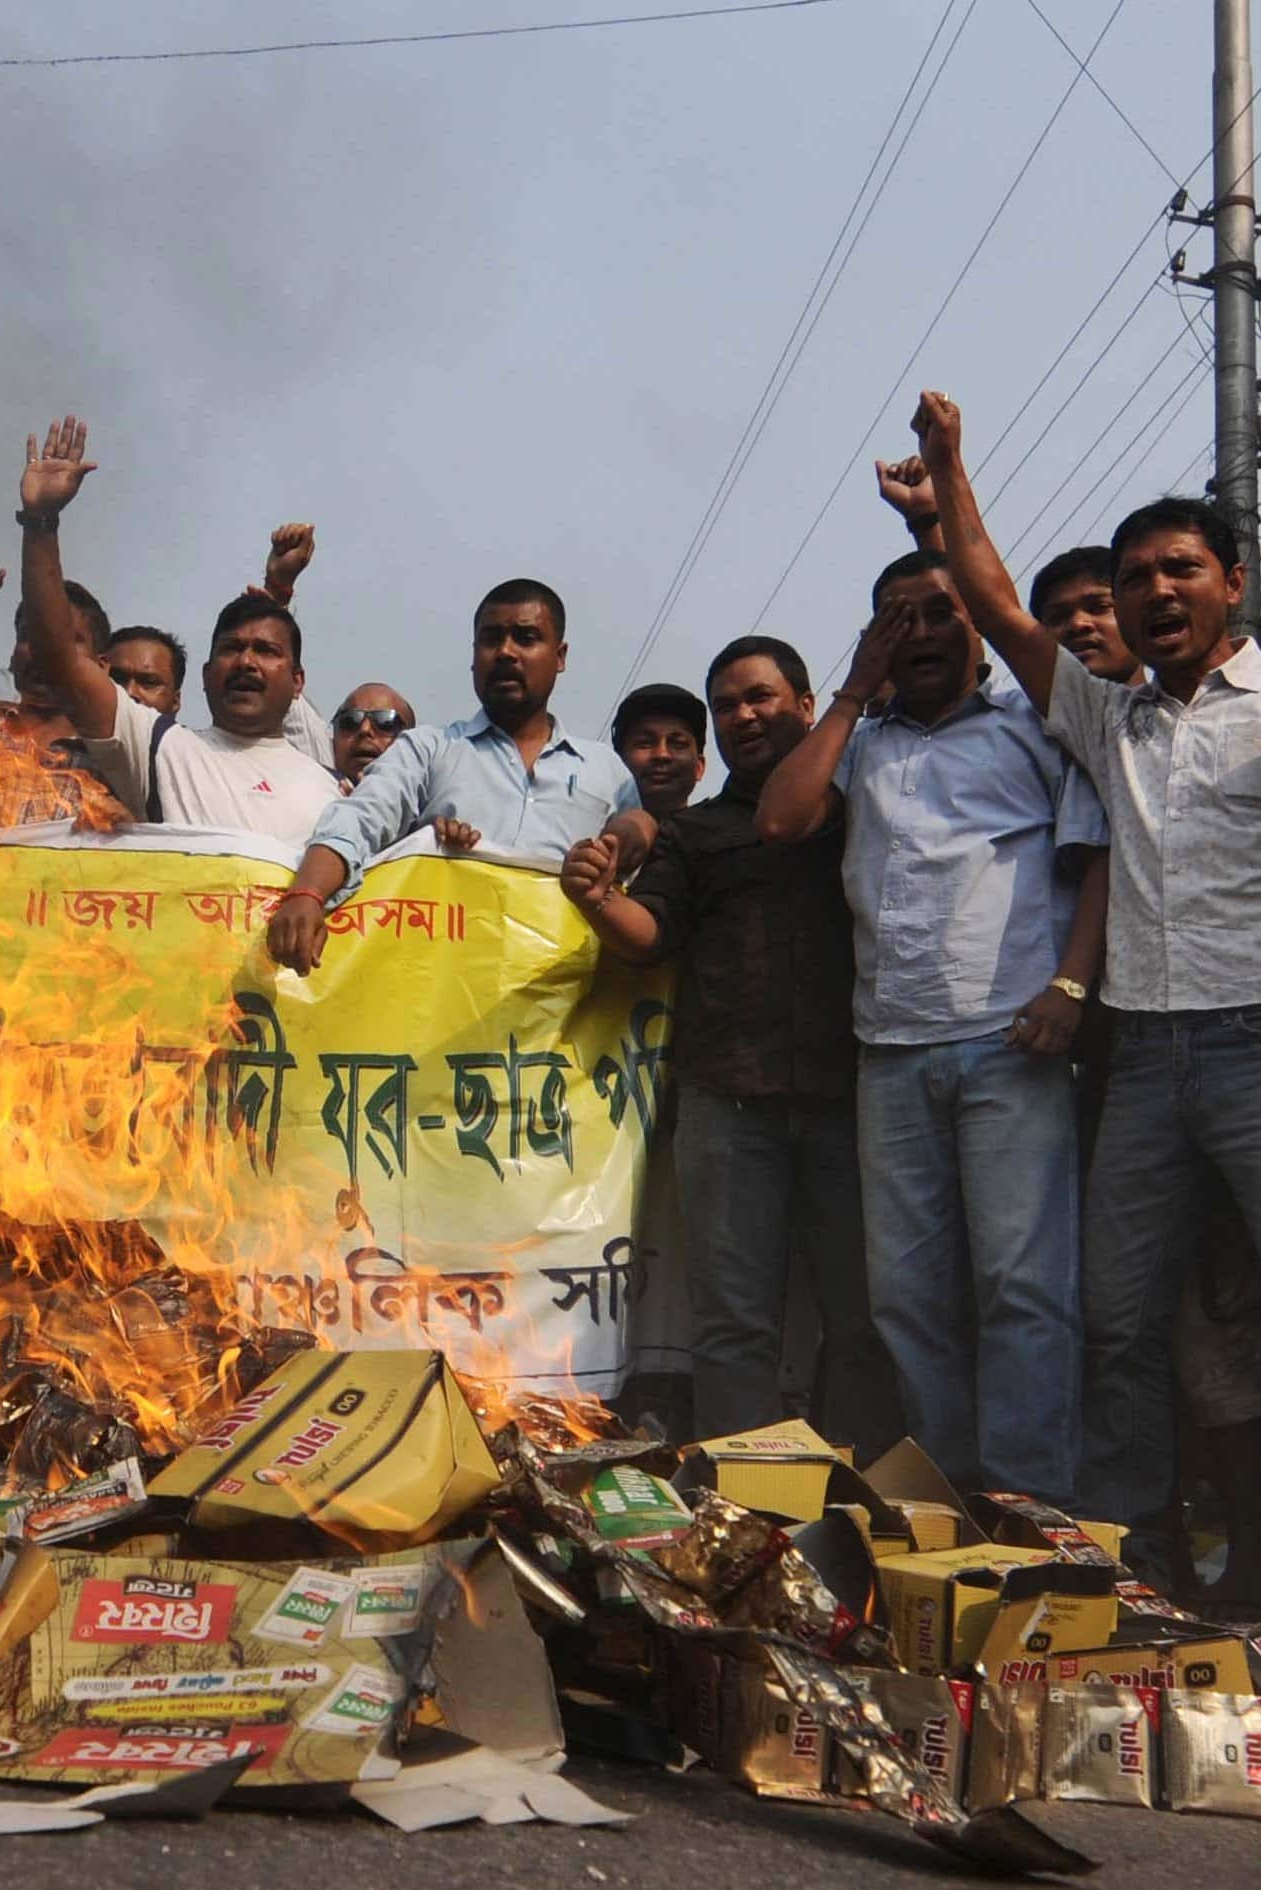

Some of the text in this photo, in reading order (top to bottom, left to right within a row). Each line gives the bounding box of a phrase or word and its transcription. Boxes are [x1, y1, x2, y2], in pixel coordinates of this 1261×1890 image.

[274, 1416, 346, 1468] Tulsi
[94, 1599, 214, 1641] शिखर
[1119, 1718, 1145, 1775] Tulsi
